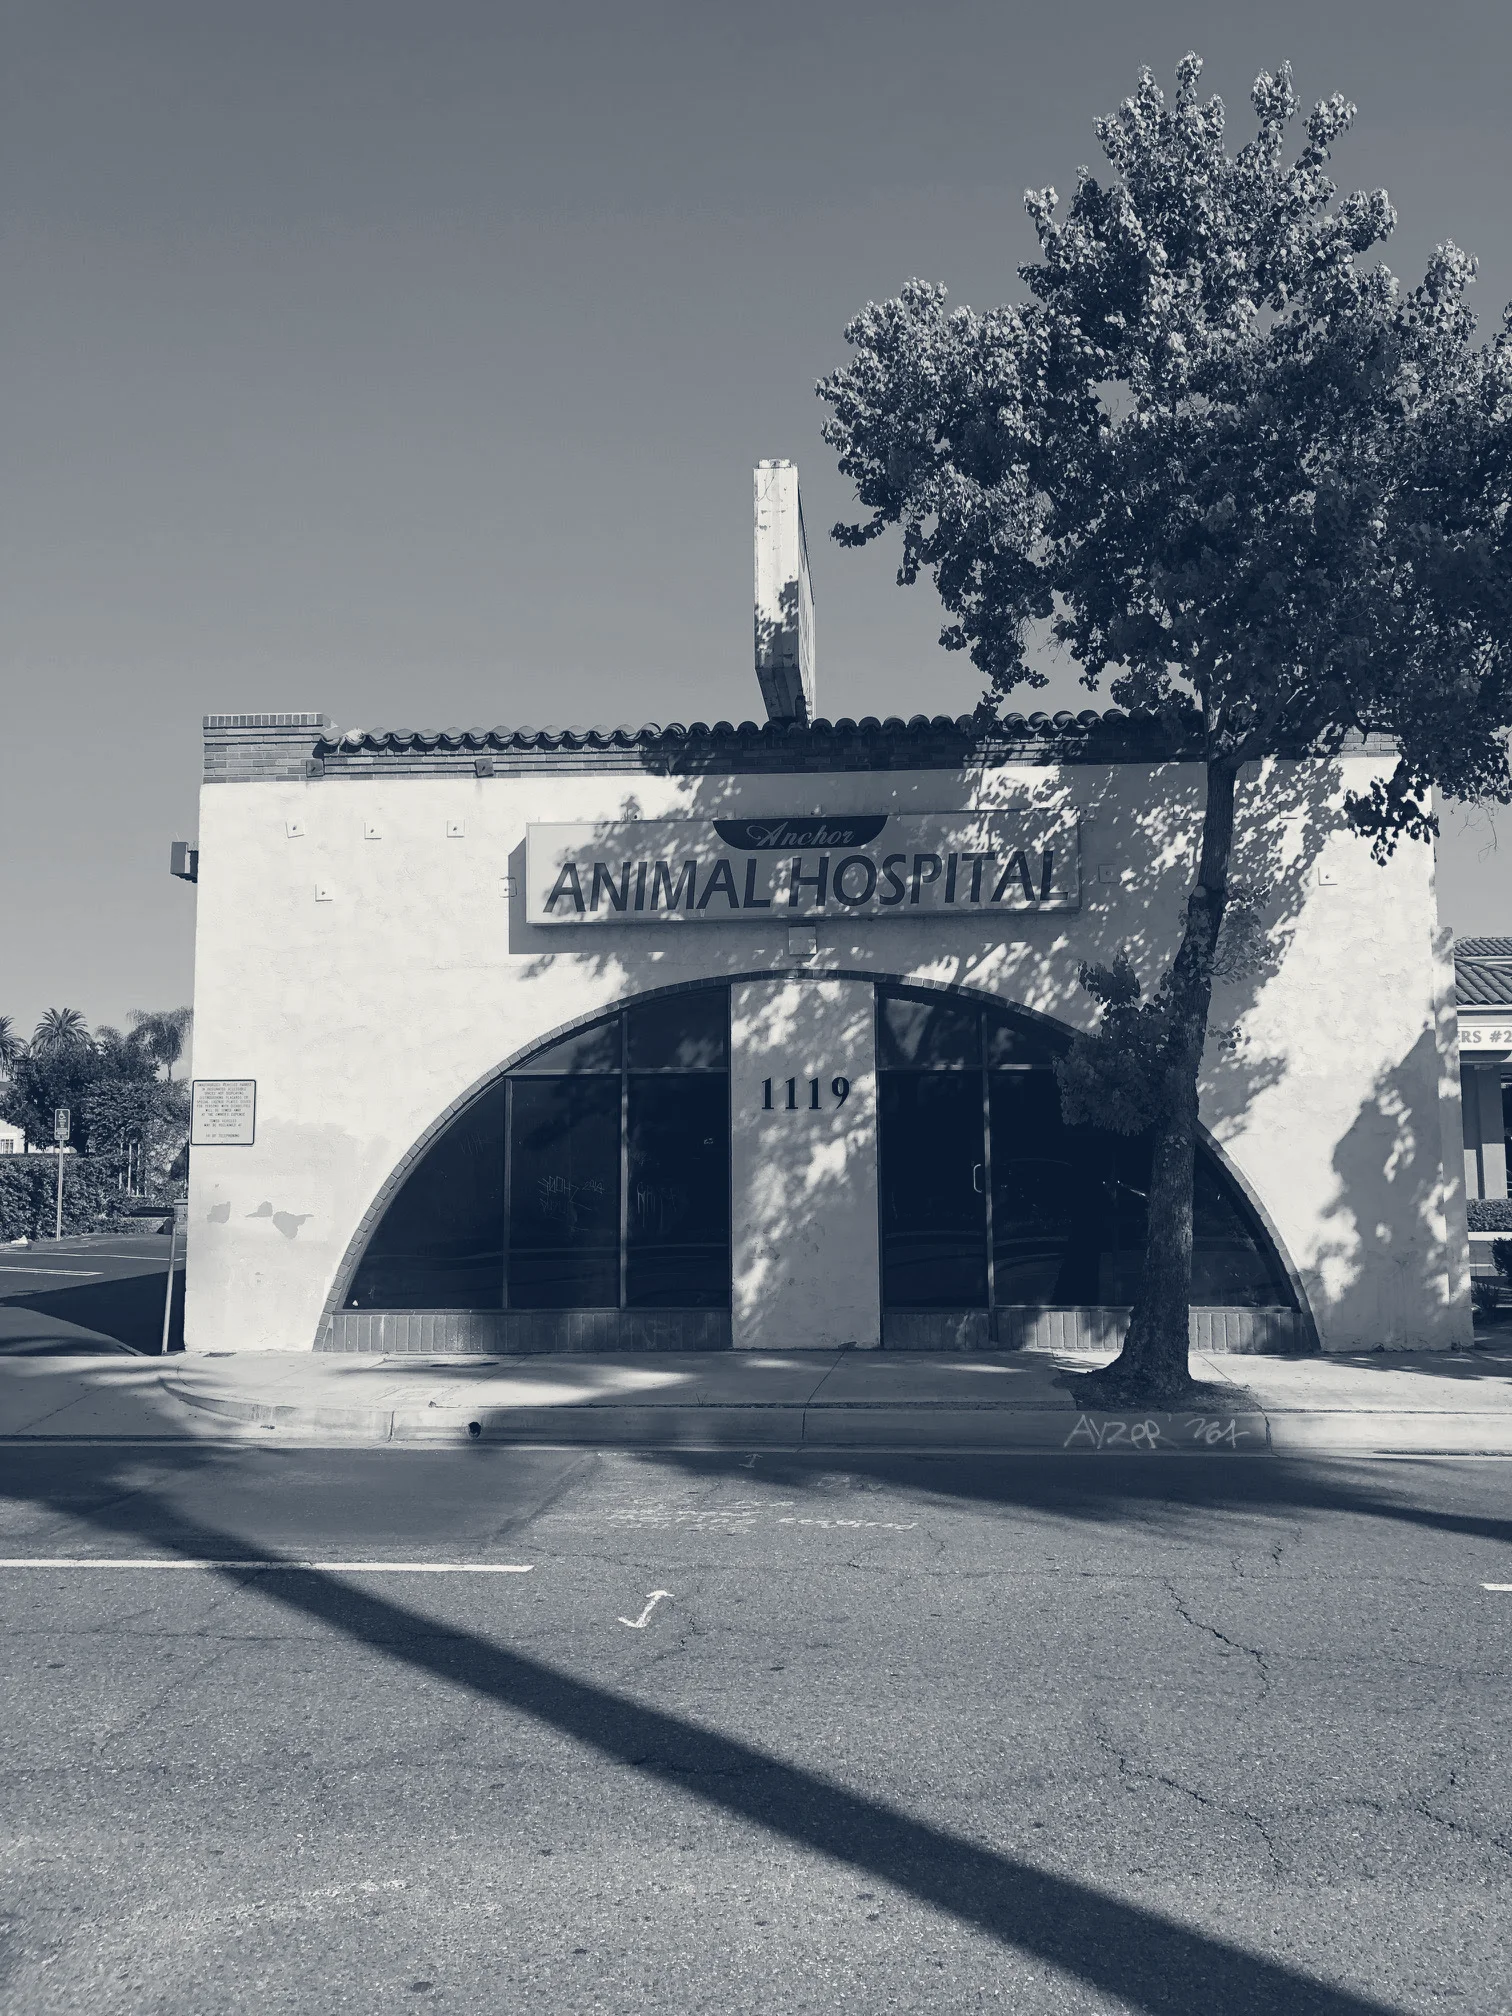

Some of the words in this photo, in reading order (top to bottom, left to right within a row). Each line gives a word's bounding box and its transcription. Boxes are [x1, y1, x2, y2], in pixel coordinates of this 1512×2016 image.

[746, 821, 855, 847] Anchor
[543, 857, 771, 914] ANIMAL
[789, 849, 1069, 909] HOSPITAL
[761, 1076, 850, 1110] 1119
